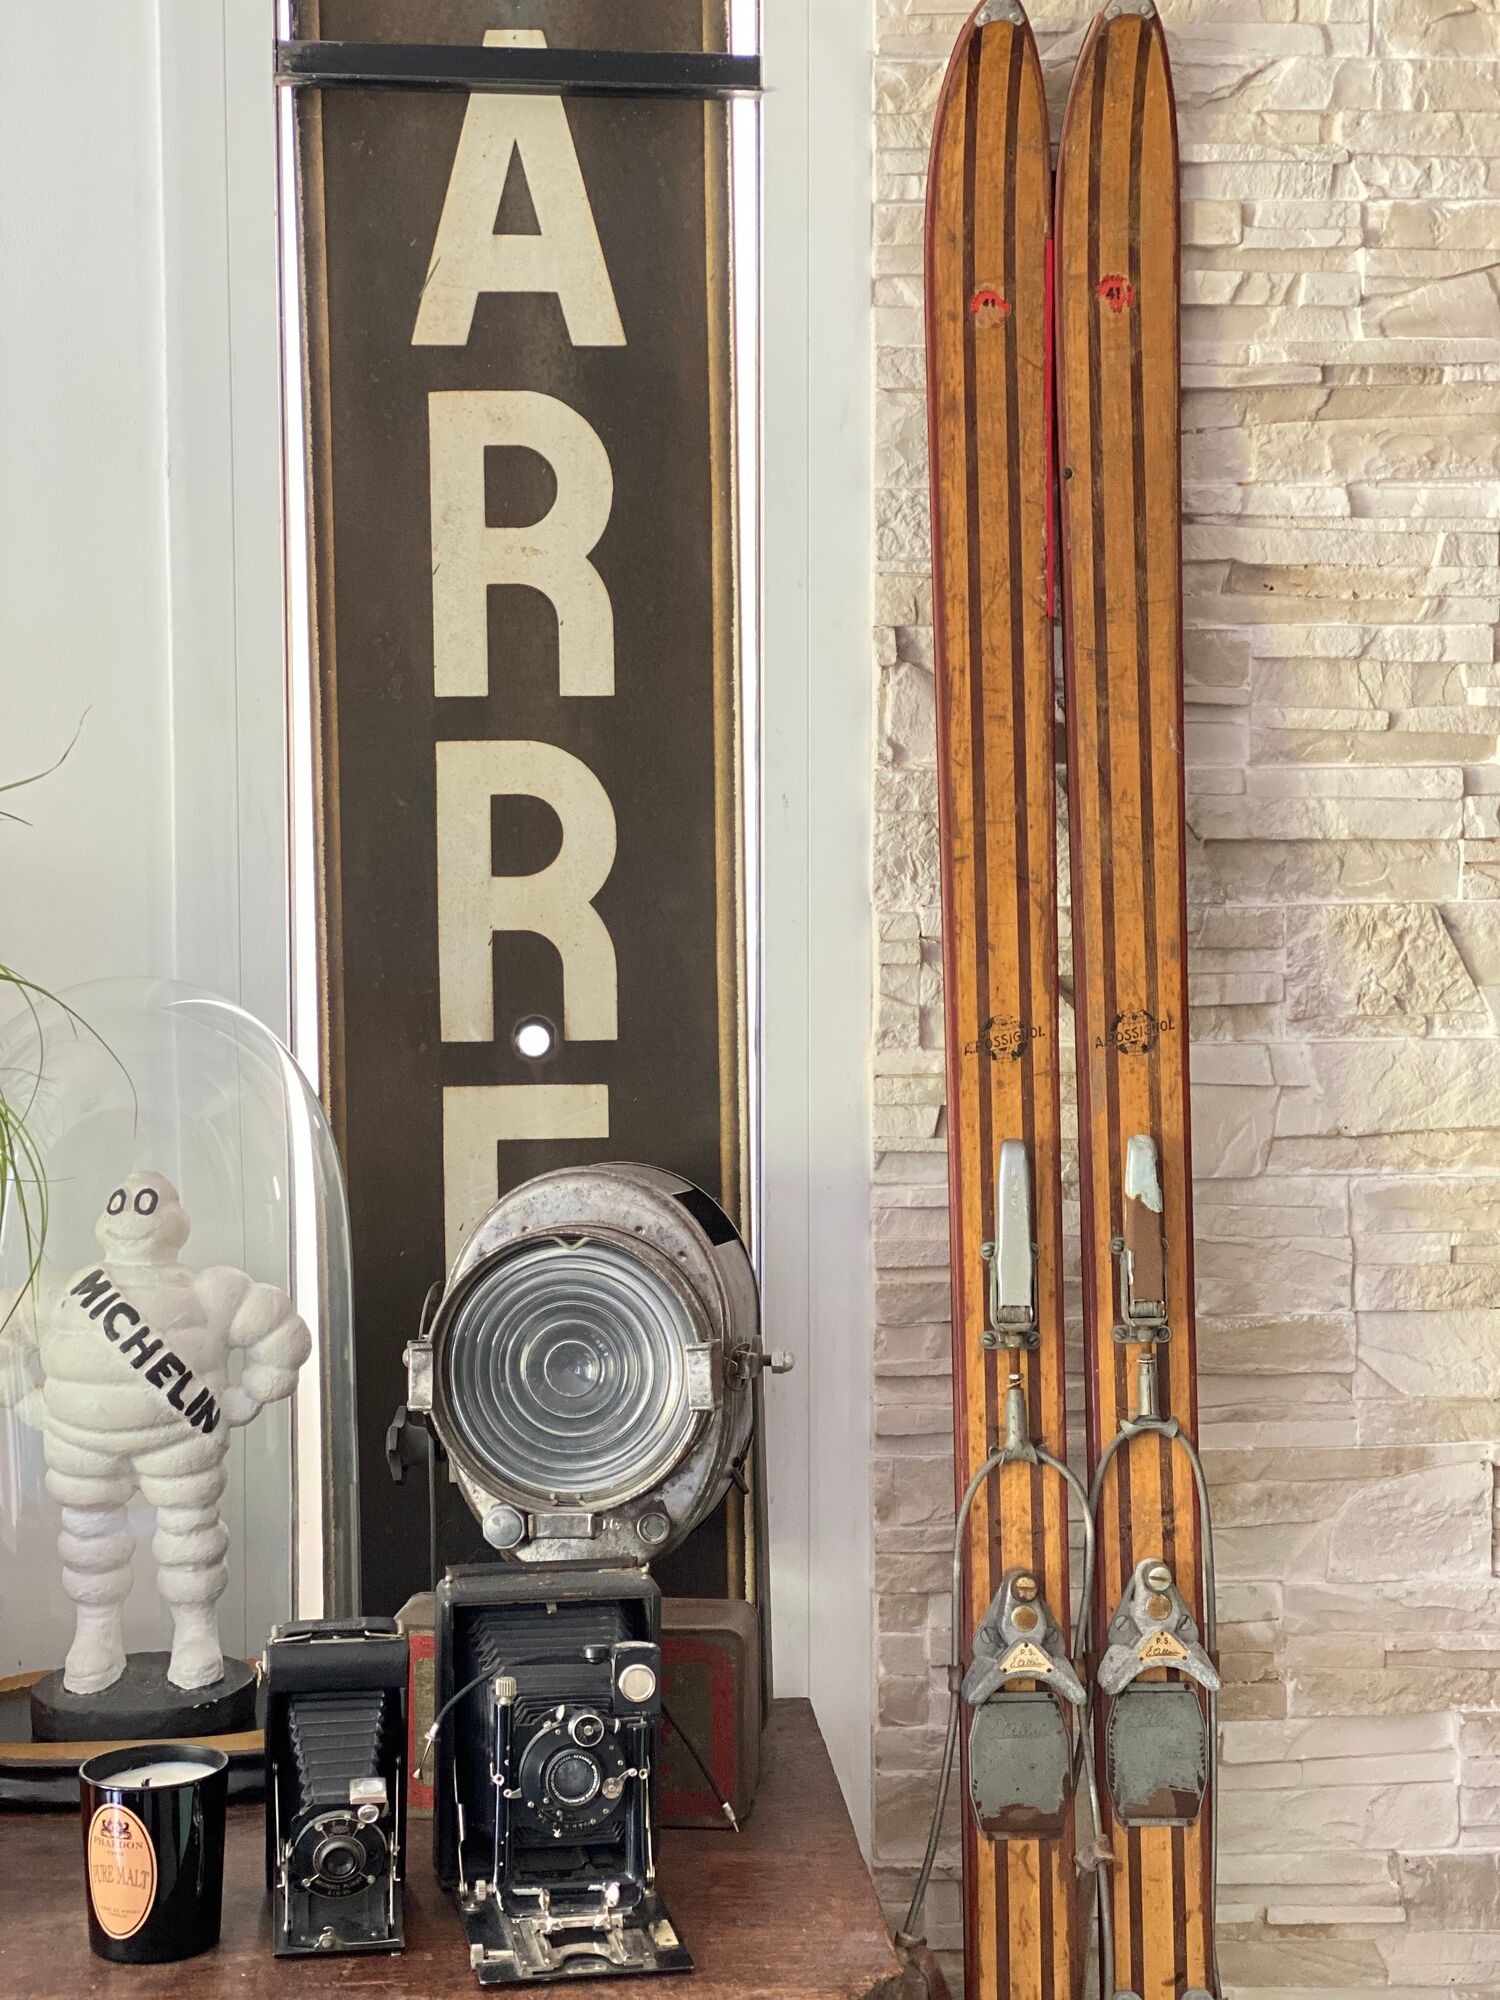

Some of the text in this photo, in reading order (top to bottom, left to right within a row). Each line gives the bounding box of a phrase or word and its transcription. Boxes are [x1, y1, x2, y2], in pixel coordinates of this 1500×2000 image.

[69, 1268, 221, 1434] MICHELIN
[92, 1864, 150, 1890] PURE MALT
